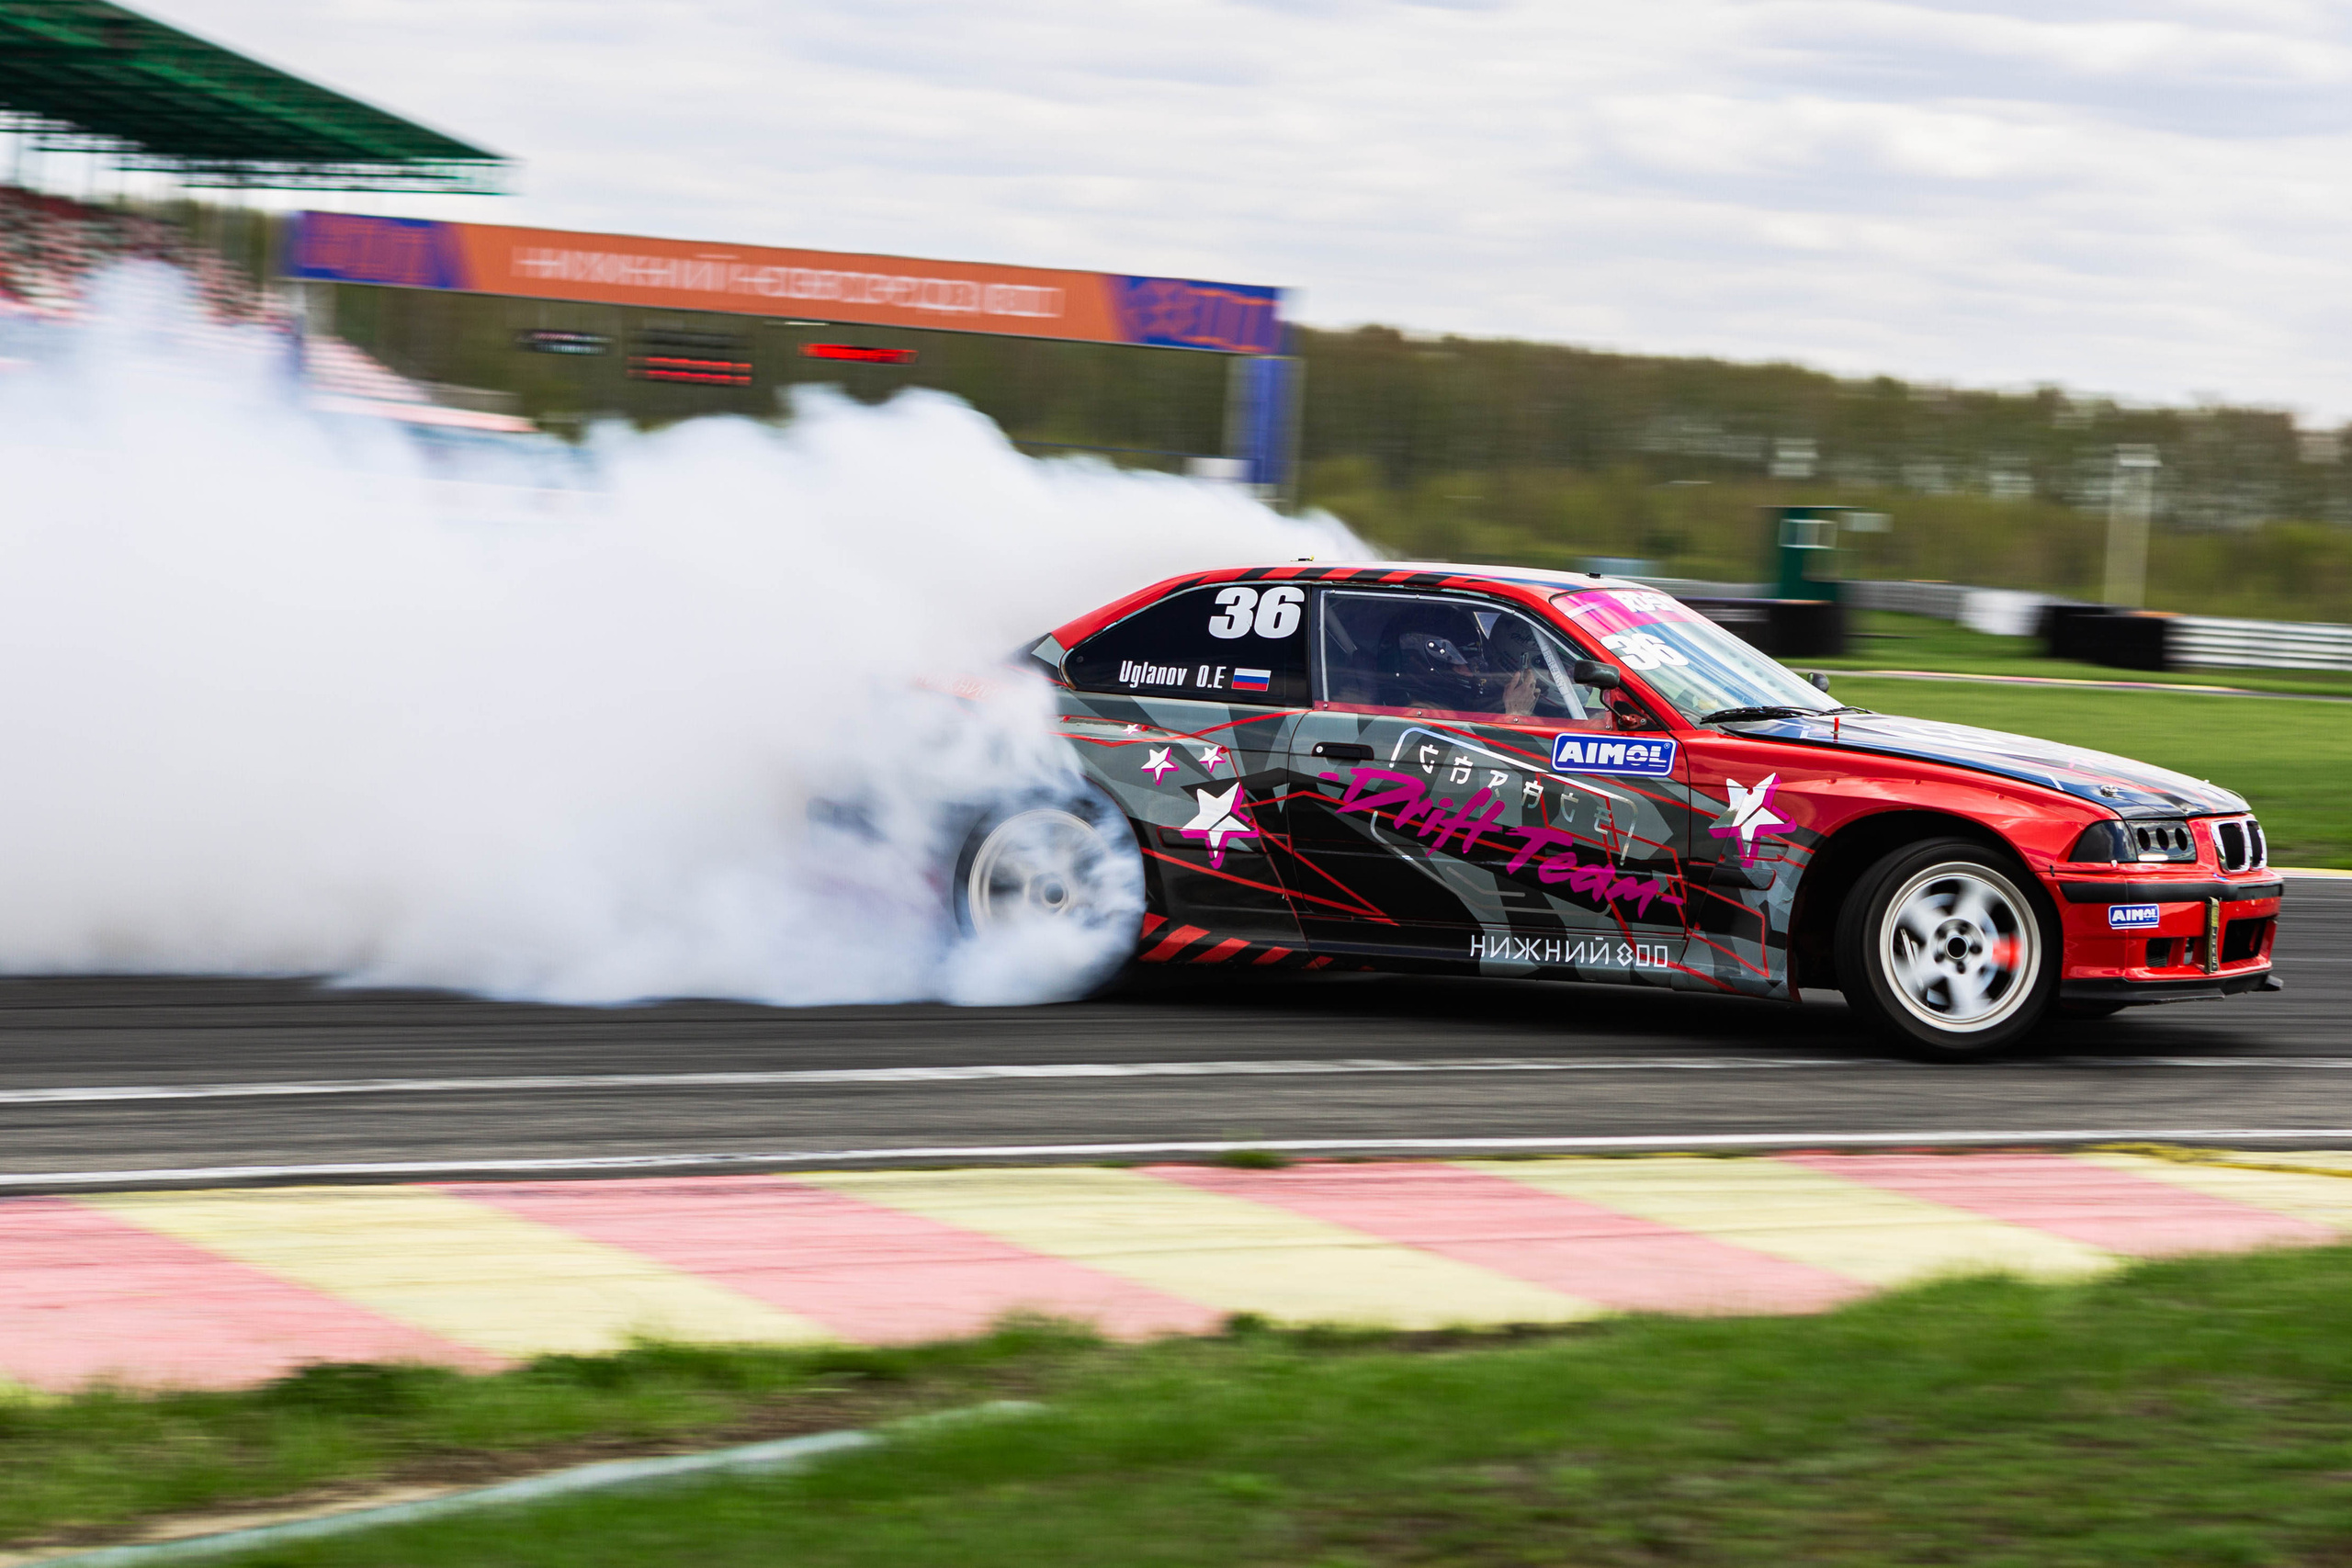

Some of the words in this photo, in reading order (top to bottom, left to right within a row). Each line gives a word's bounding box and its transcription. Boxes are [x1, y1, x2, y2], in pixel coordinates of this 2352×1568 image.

[1208, 586, 1306, 639] 36
[1600, 633, 1689, 671] 36
[1118, 660, 1188, 689] Uglanov
[1557, 741, 1668, 768] AIMOL
[1336, 768, 1507, 856] Drift
[1505, 826, 1660, 919] Team
[2111, 908, 2158, 921] AIMOL
[1470, 935, 1610, 965] НИЖНИЙ
